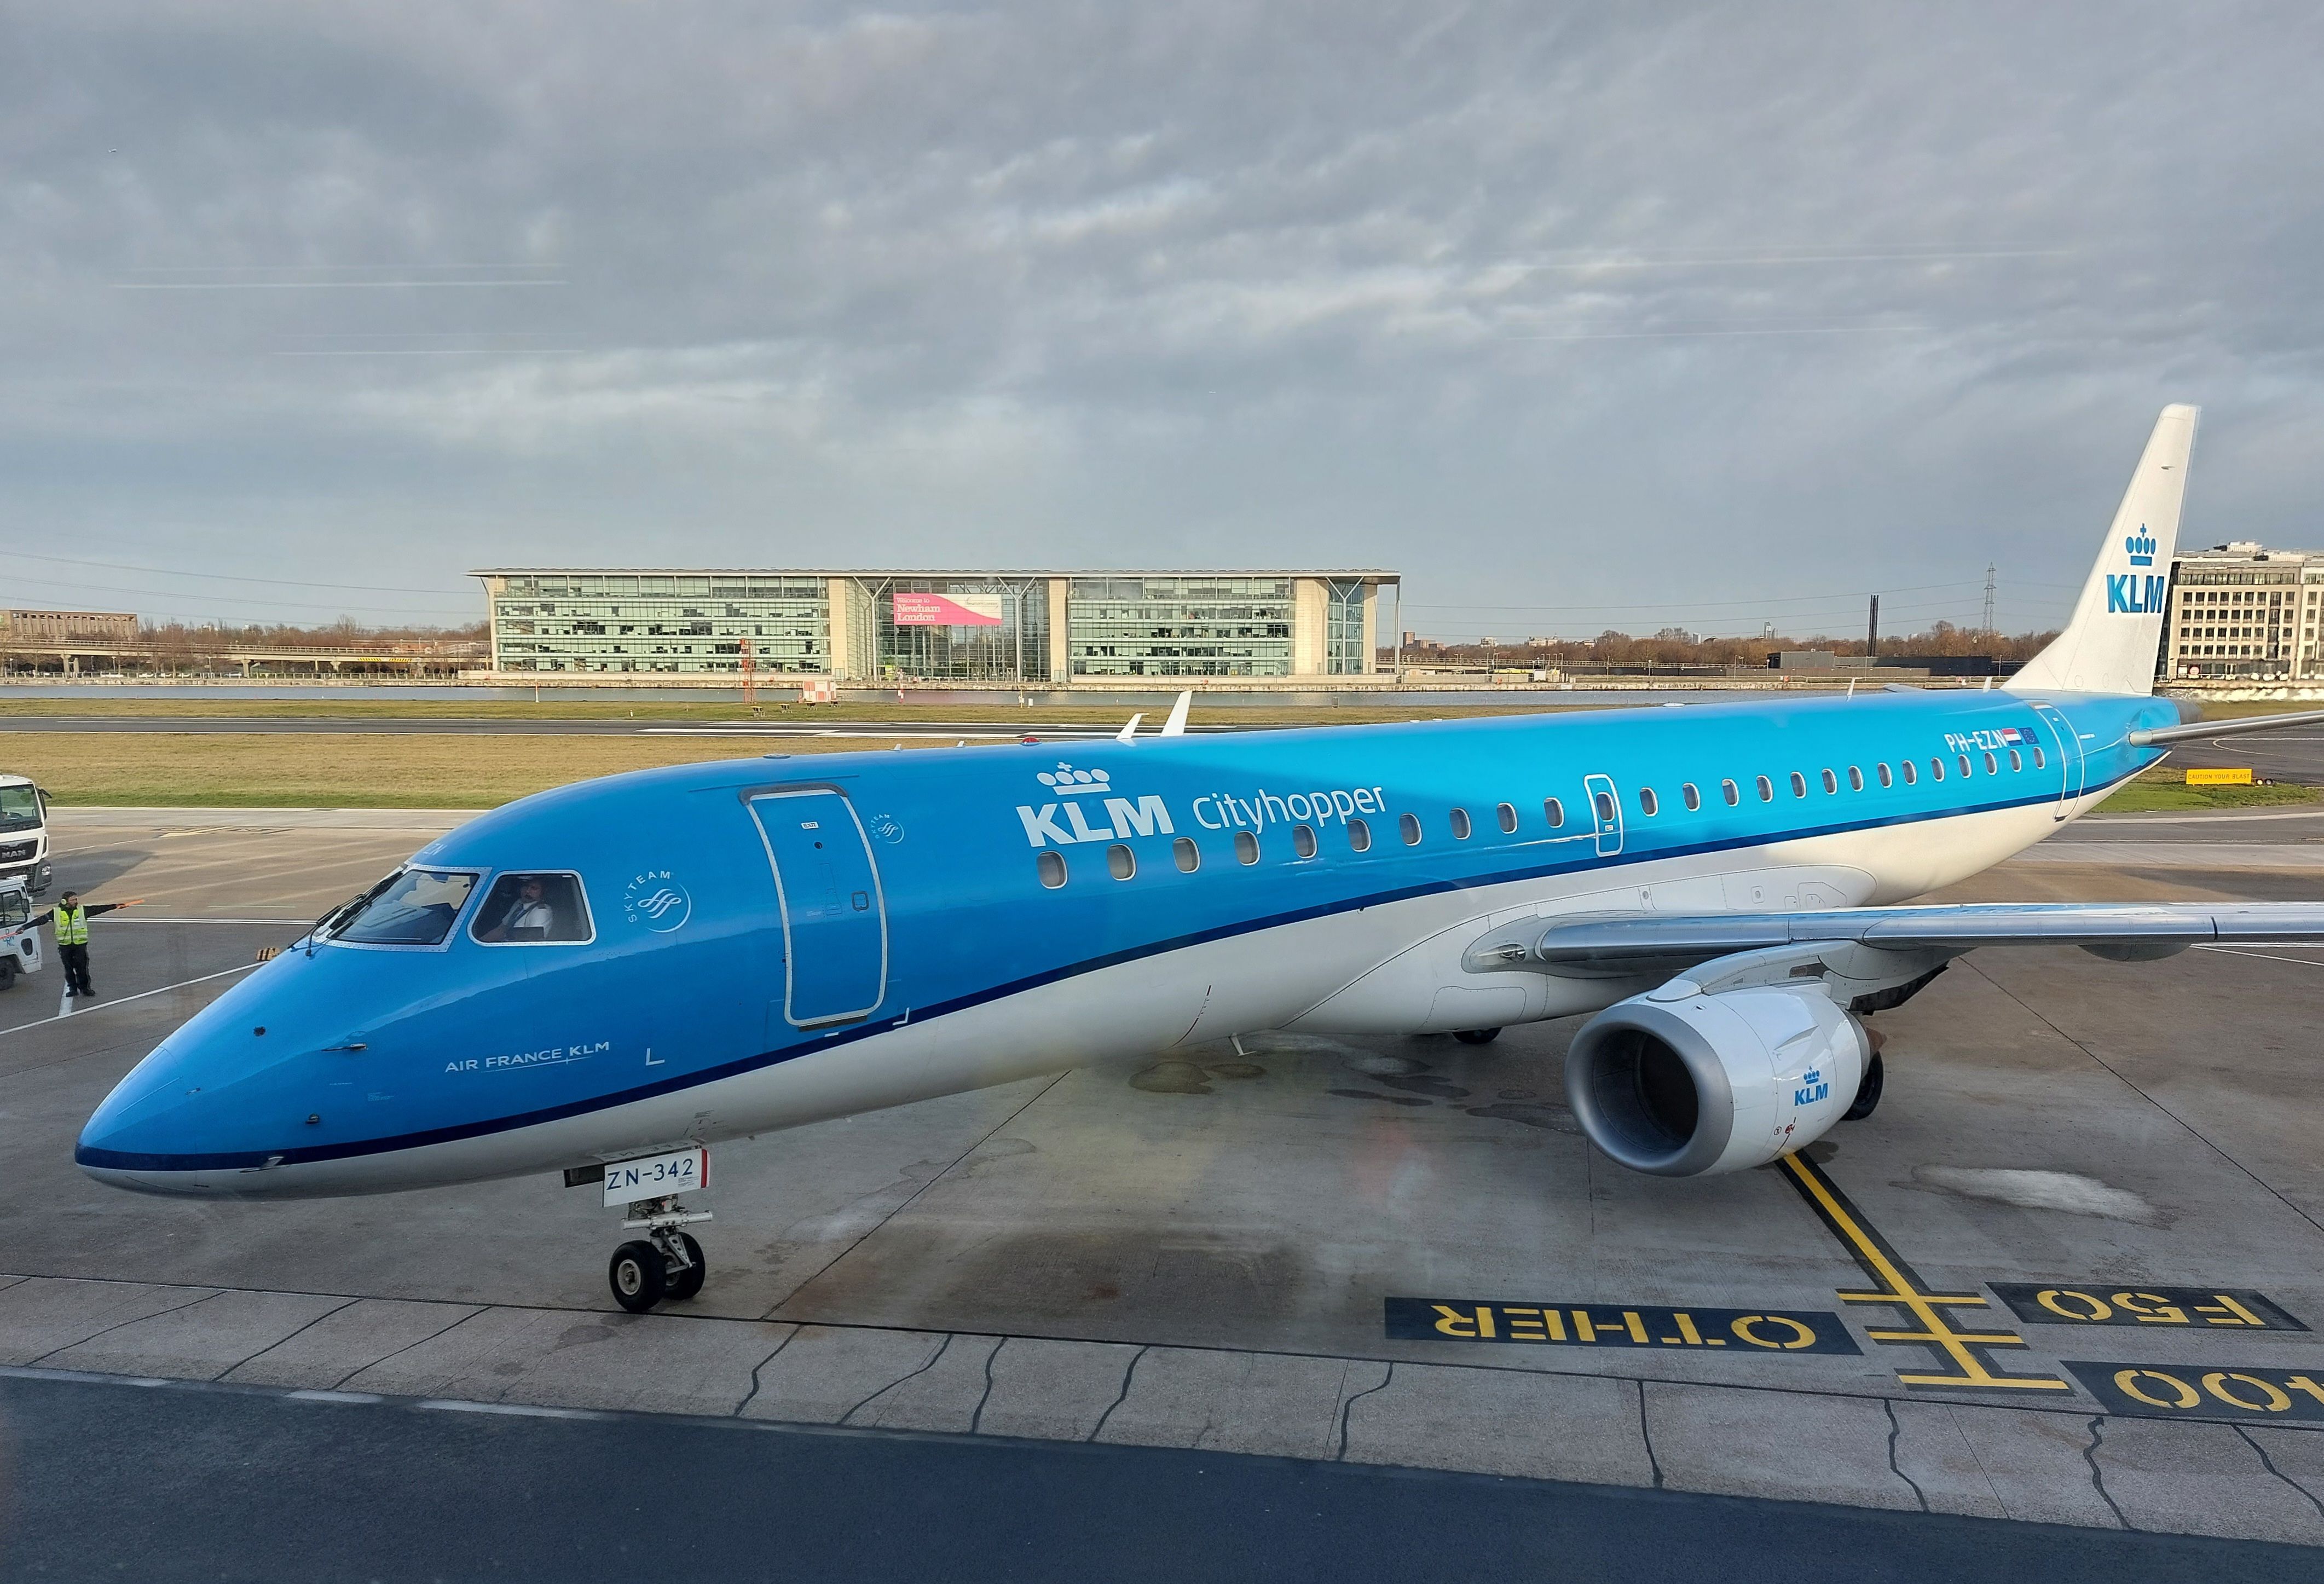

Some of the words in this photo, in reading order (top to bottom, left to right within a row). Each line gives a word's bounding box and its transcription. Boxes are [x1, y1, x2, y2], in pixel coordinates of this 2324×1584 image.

[897, 604, 941, 612] Newham
[2106, 574, 2165, 613] KLM
[897, 613, 936, 621] London
[1944, 729, 2008, 753] PH-EZN
[1015, 795, 1175, 847] KLM
[1192, 786, 1387, 834] Cityhopper
[2, 849, 26, 858] MAN
[624, 870, 670, 923] SKYTEAM
[444, 1059, 479, 1073] AIR
[485, 1048, 562, 1067] FRANCE
[569, 1041, 609, 1056] KLM
[1794, 1082, 1828, 1106] KLM
[606, 1158, 693, 1190] ZN-342
[2037, 1290, 2267, 1326] F50
[1430, 1304, 1817, 1350] OTHER
